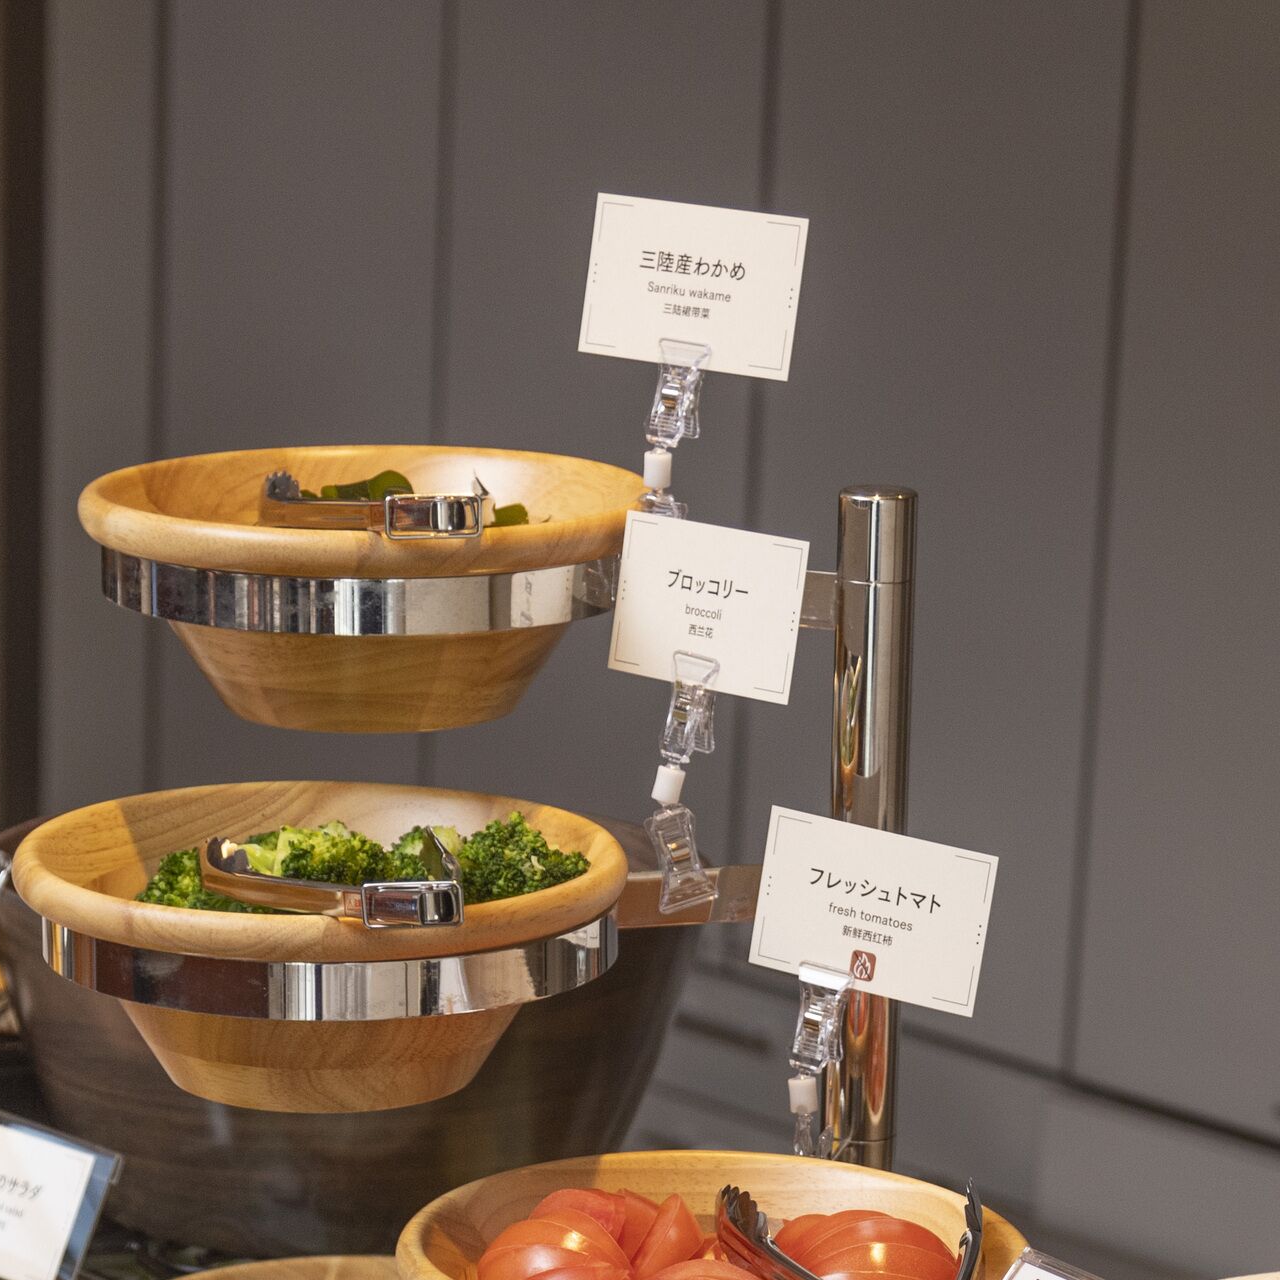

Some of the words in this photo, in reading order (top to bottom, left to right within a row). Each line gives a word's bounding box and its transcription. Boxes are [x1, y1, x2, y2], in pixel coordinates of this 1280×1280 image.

[639, 250, 746, 281] 三陸産わかめ
[647, 281, 686, 297] Sanriku
[689, 288, 731, 303] wakame
[667, 568, 749, 599] ブロッコリー
[685, 604, 722, 620] broccoli
[688, 624, 714, 639] 西兰花
[809, 867, 942, 914] フレッシュトマト
[828, 902, 856, 918] fresh
[860, 911, 913, 932] tomatoes
[842, 925, 893, 946] 新鲜西红柿
